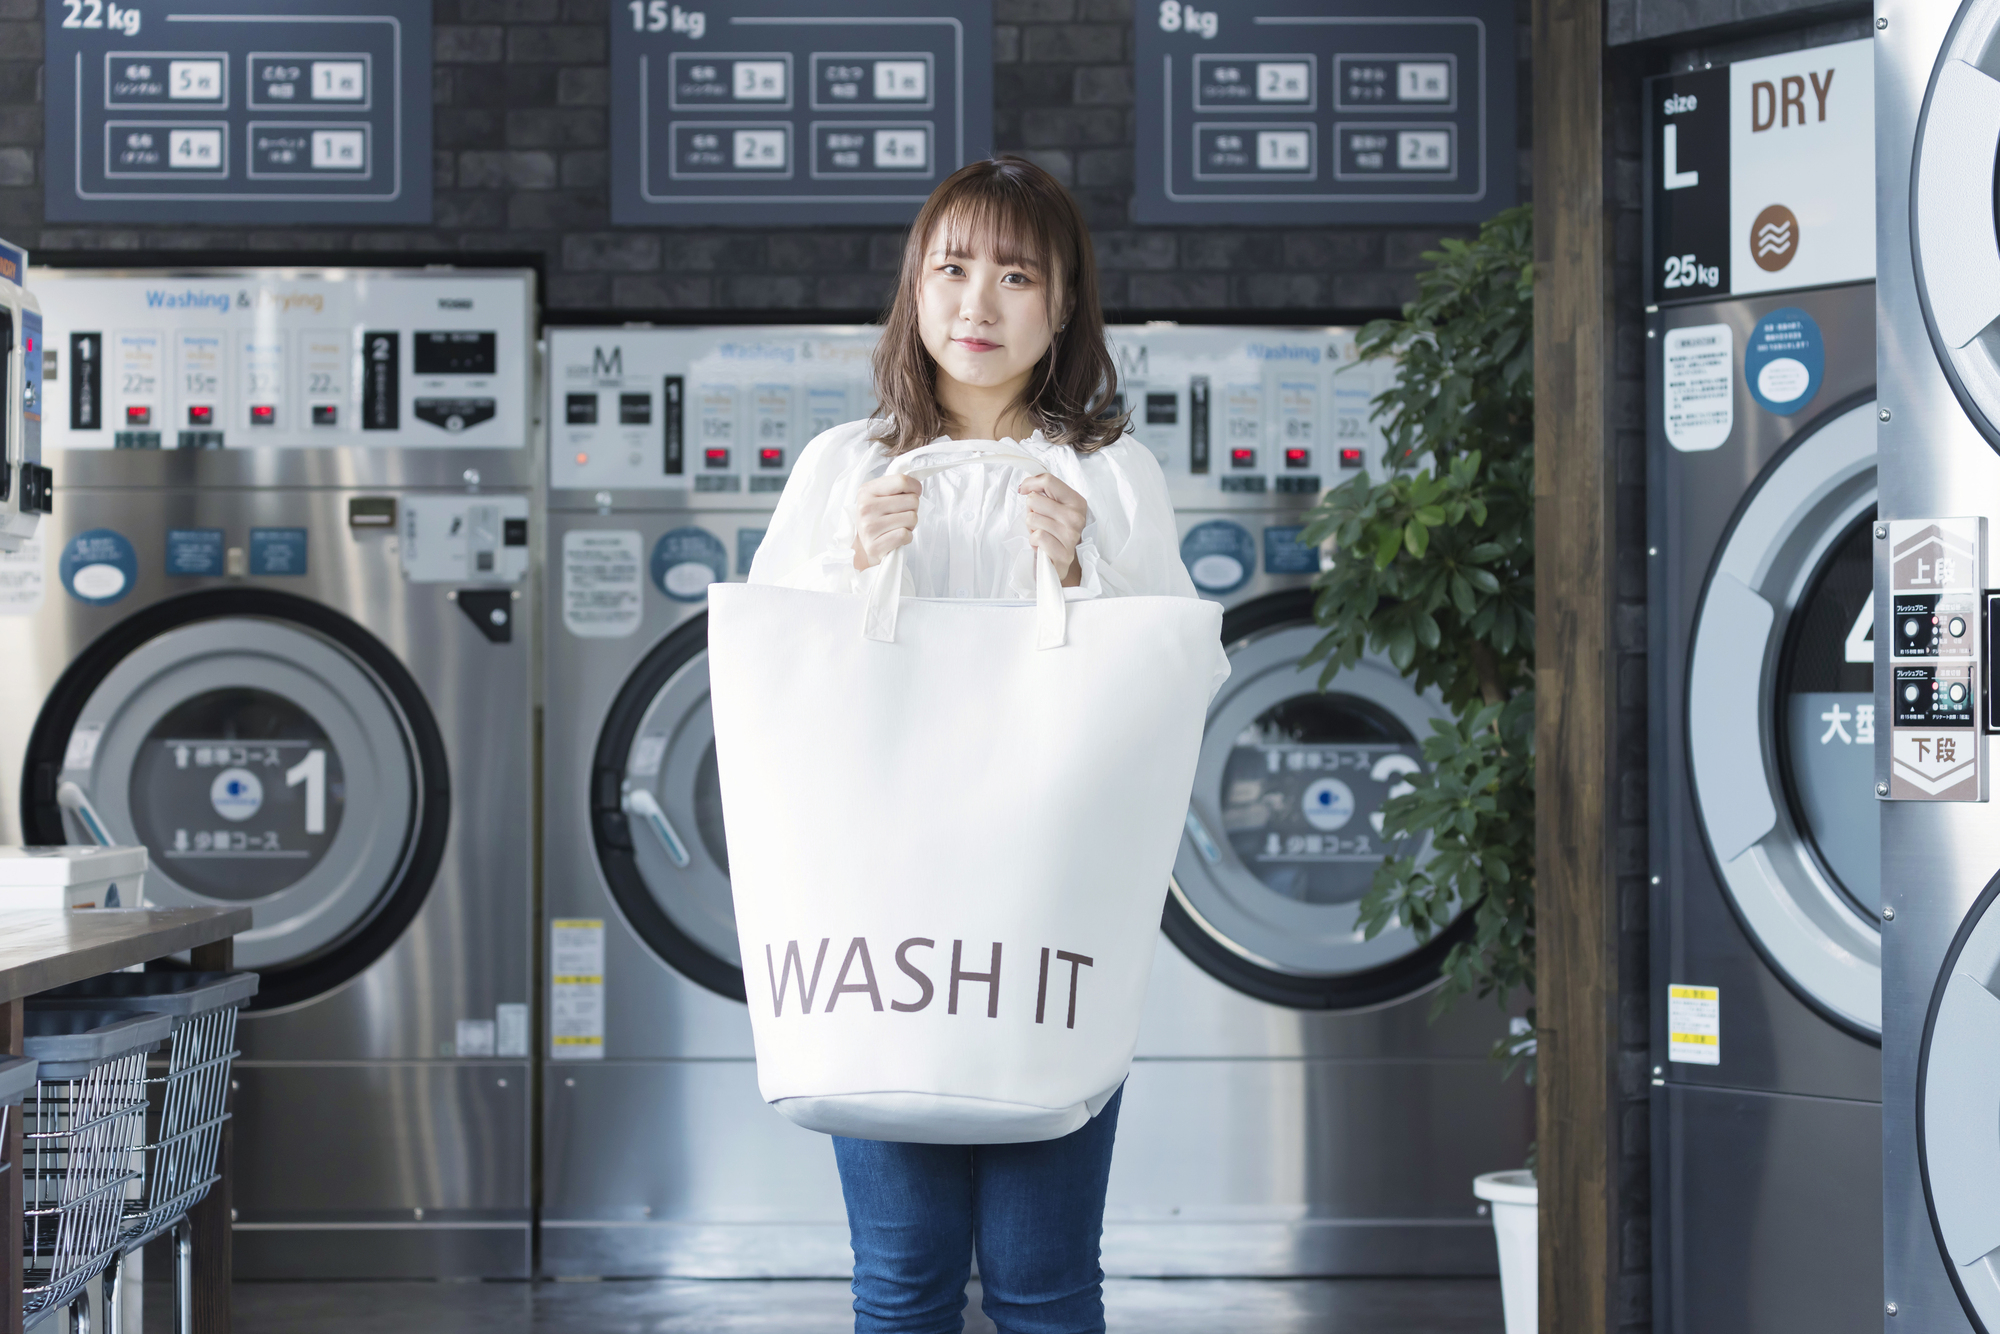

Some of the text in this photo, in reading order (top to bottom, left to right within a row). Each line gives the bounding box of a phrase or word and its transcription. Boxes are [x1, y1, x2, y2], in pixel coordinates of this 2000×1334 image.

[1664, 93, 1698, 115] size
[1752, 68, 1836, 133] DRY
[1664, 124, 1699, 190] L
[1664, 254, 1719, 289] 25kg
[146, 290, 231, 313] Washing
[236, 289, 250, 309] &
[78, 338, 92, 361] 1
[372, 338, 390, 361] 2
[593, 346, 623, 375] M
[1121, 346, 1149, 375] M
[1247, 343, 1339, 363] Washing &
[1910, 558, 1956, 584] 上段
[1911, 737, 1956, 763] 下段
[286, 748, 326, 835] 1
[765, 936, 1094, 1030] WASH IT
